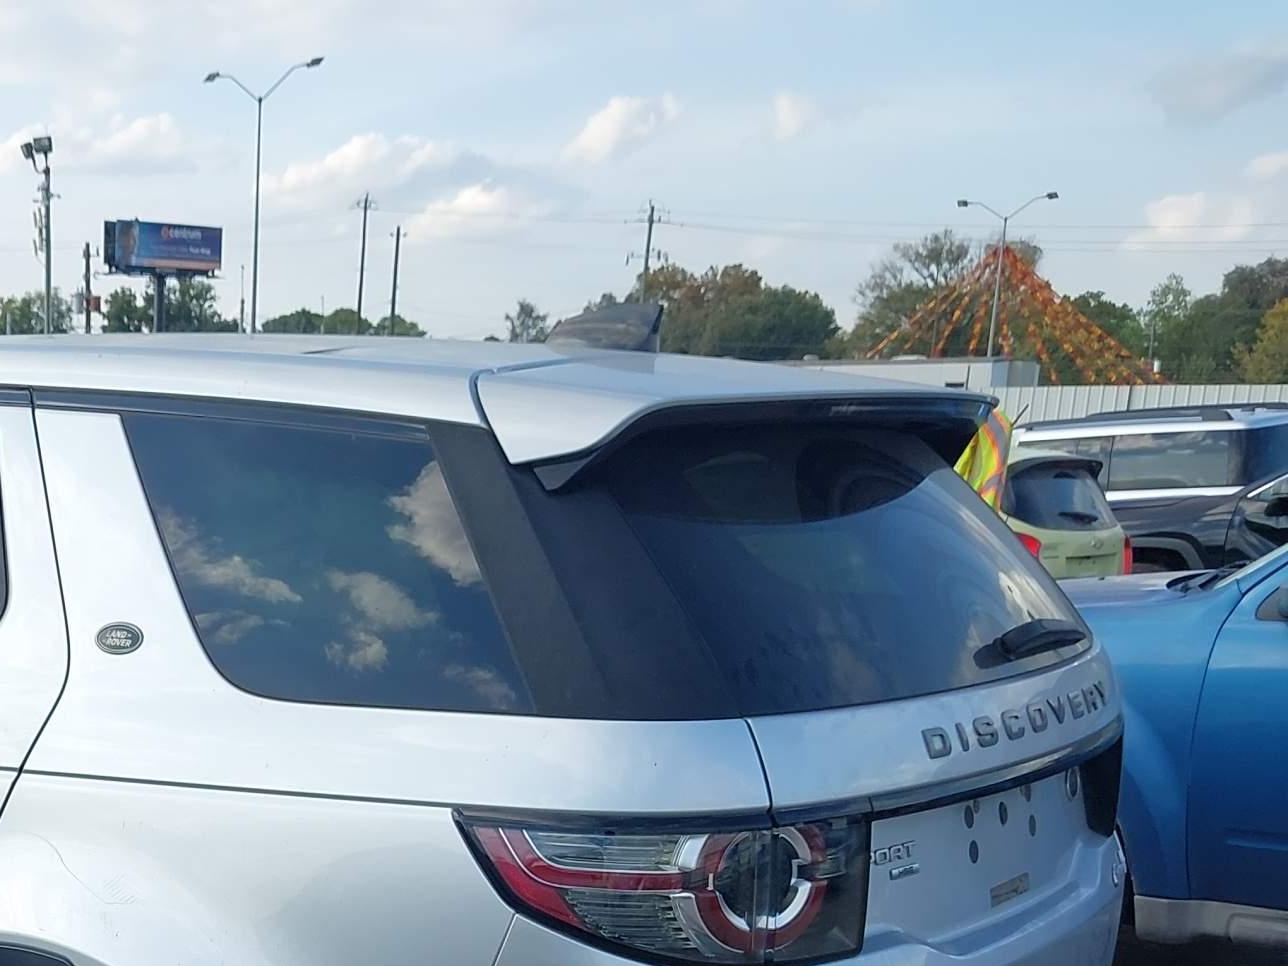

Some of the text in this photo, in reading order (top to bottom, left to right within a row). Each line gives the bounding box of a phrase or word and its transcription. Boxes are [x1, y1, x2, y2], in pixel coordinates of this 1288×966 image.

[105, 629, 128, 639] LAND
[105, 637, 132, 647] ROVER
[921, 680, 1109, 760] DISCOVERY
